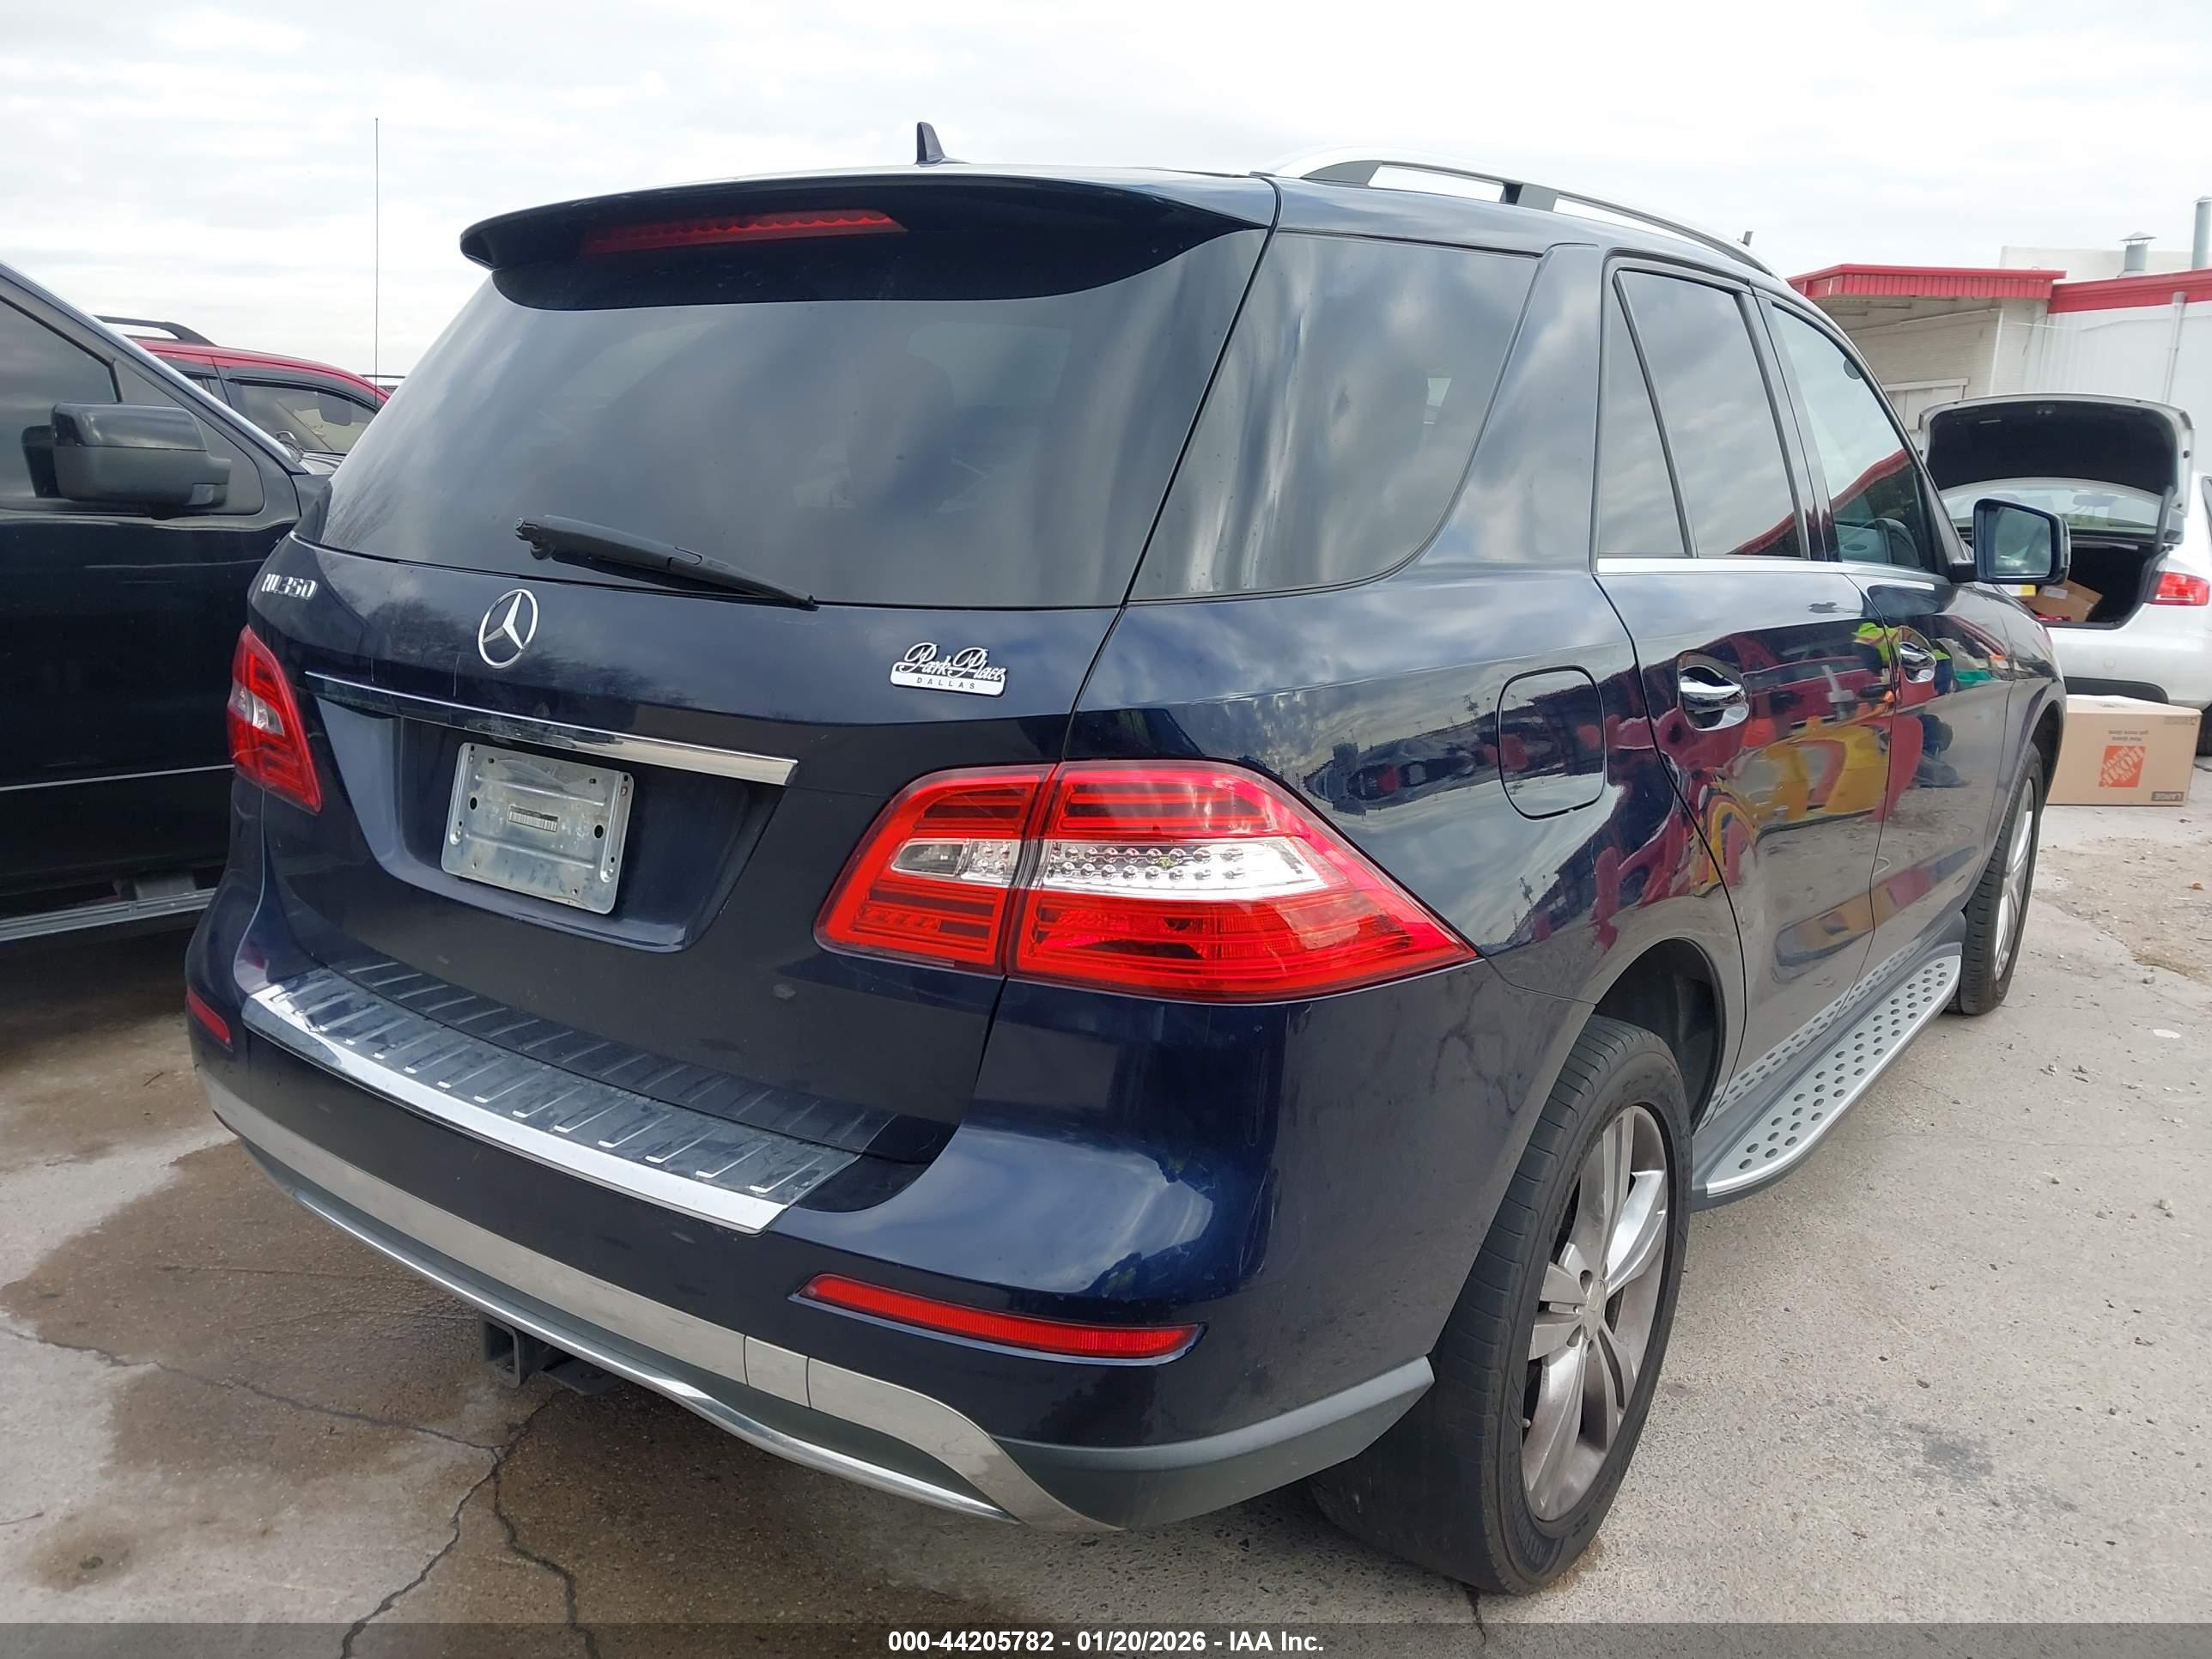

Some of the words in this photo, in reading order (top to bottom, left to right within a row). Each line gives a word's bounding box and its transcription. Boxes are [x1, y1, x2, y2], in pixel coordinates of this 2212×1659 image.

[898, 641, 951, 676] Park
[947, 647, 1006, 680] Place
[916, 677, 975, 690] DALLAS
